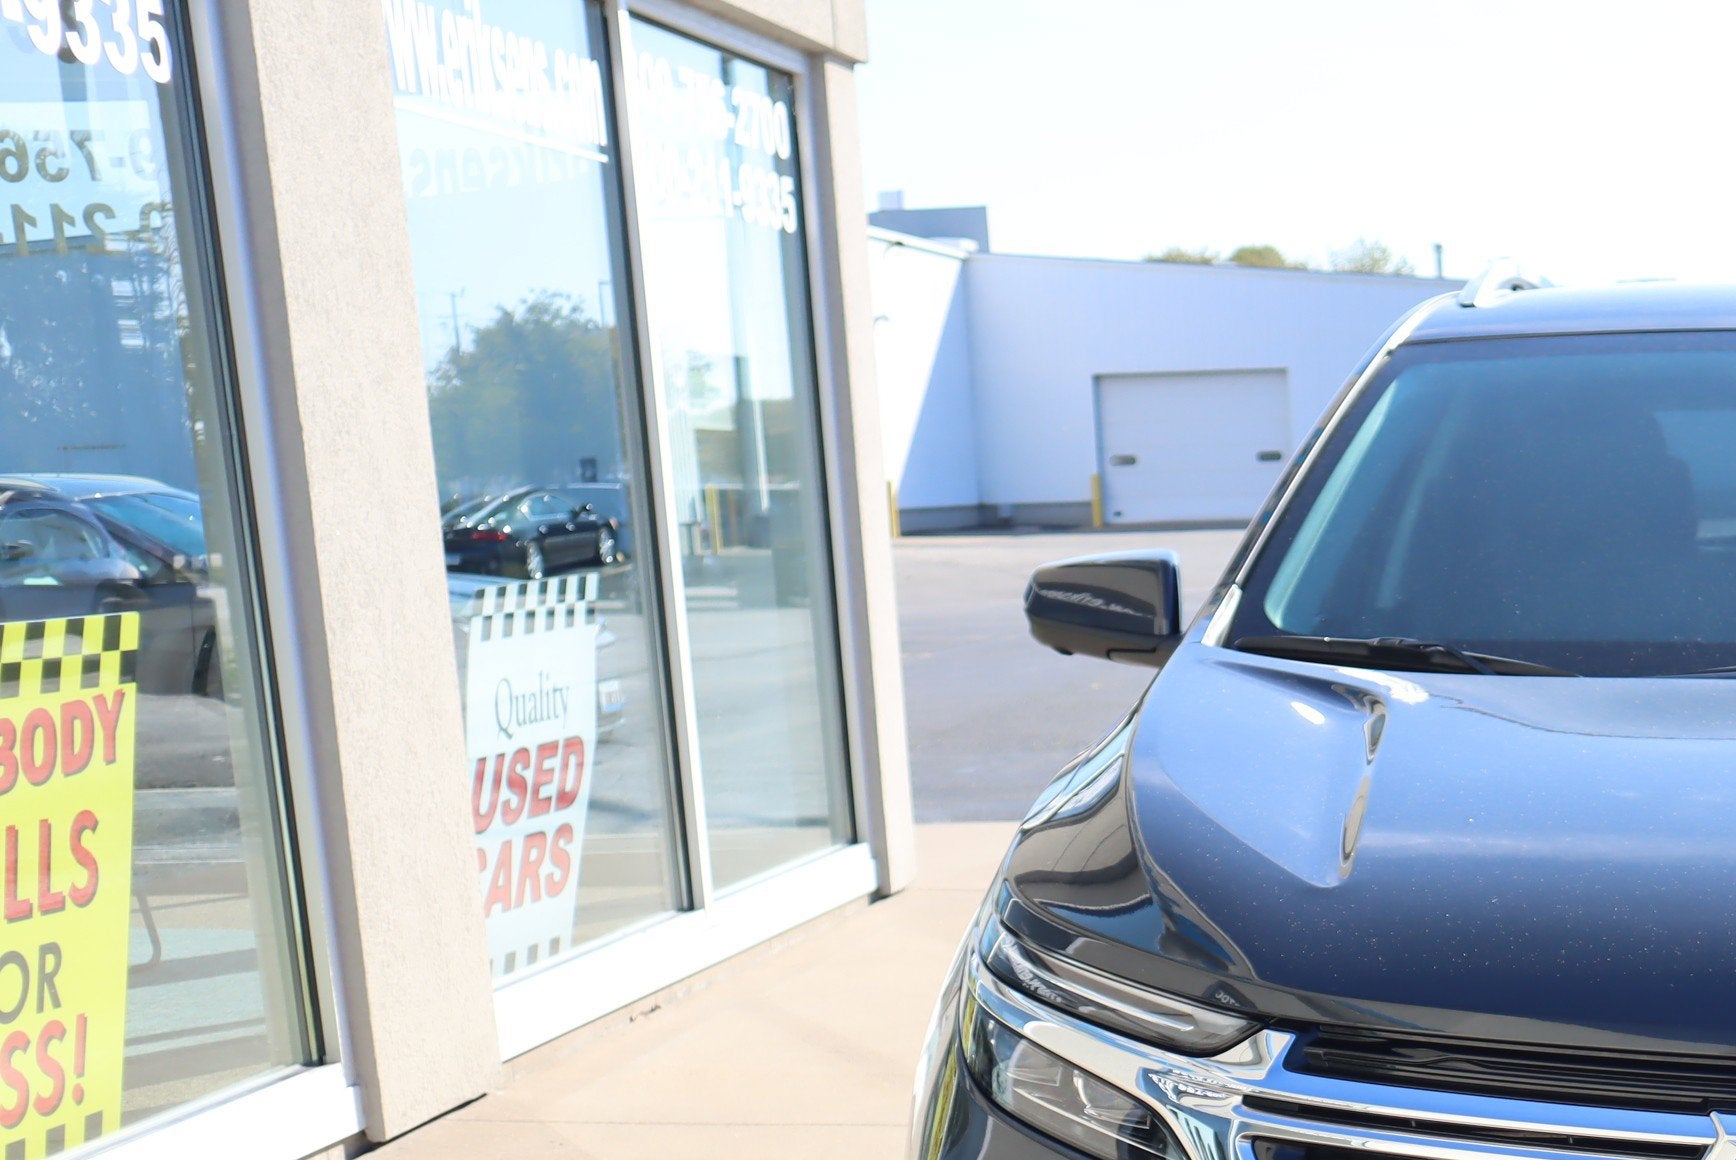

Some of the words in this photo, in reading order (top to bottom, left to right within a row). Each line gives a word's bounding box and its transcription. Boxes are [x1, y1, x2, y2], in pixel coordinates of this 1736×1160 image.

[495, 670, 569, 740] Quality
[471, 736, 584, 835] USED
[4, 809, 99, 924] LLS
[477, 823, 574, 918] ARS
[0, 941, 62, 1025] OR
